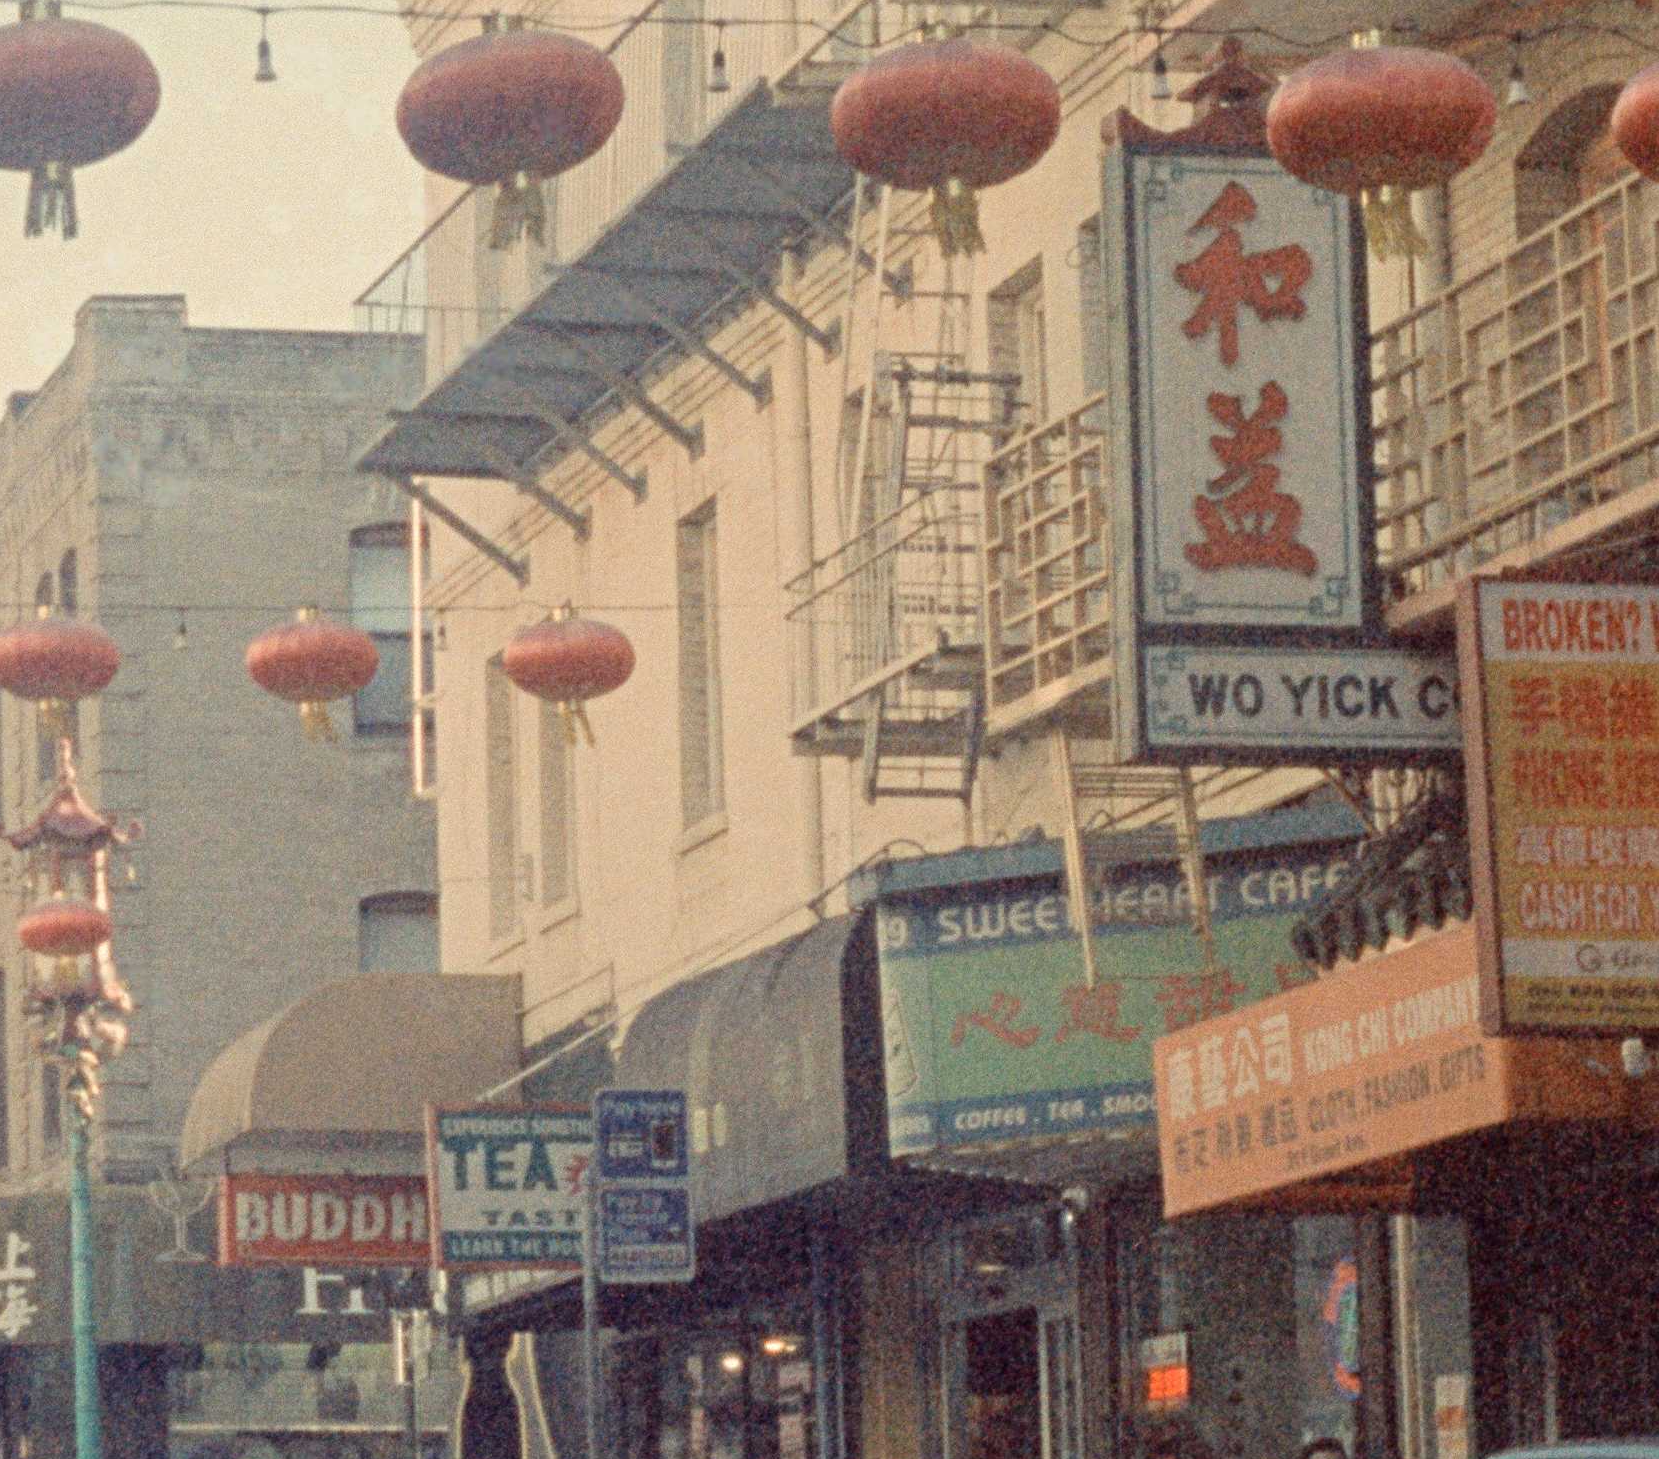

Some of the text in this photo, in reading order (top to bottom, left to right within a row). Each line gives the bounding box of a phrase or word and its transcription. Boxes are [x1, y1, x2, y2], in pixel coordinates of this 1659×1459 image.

[1502, 597, 1642, 655] BROKEN?
[1188, 671, 1265, 721] WO
[1285, 672, 1400, 721] YICK
[1520, 882, 1584, 932] CASH
[1592, 882, 1641, 932] FOR
[953, 1106, 1027, 1131] COFFEE
[442, 1136, 558, 1191] TEA
